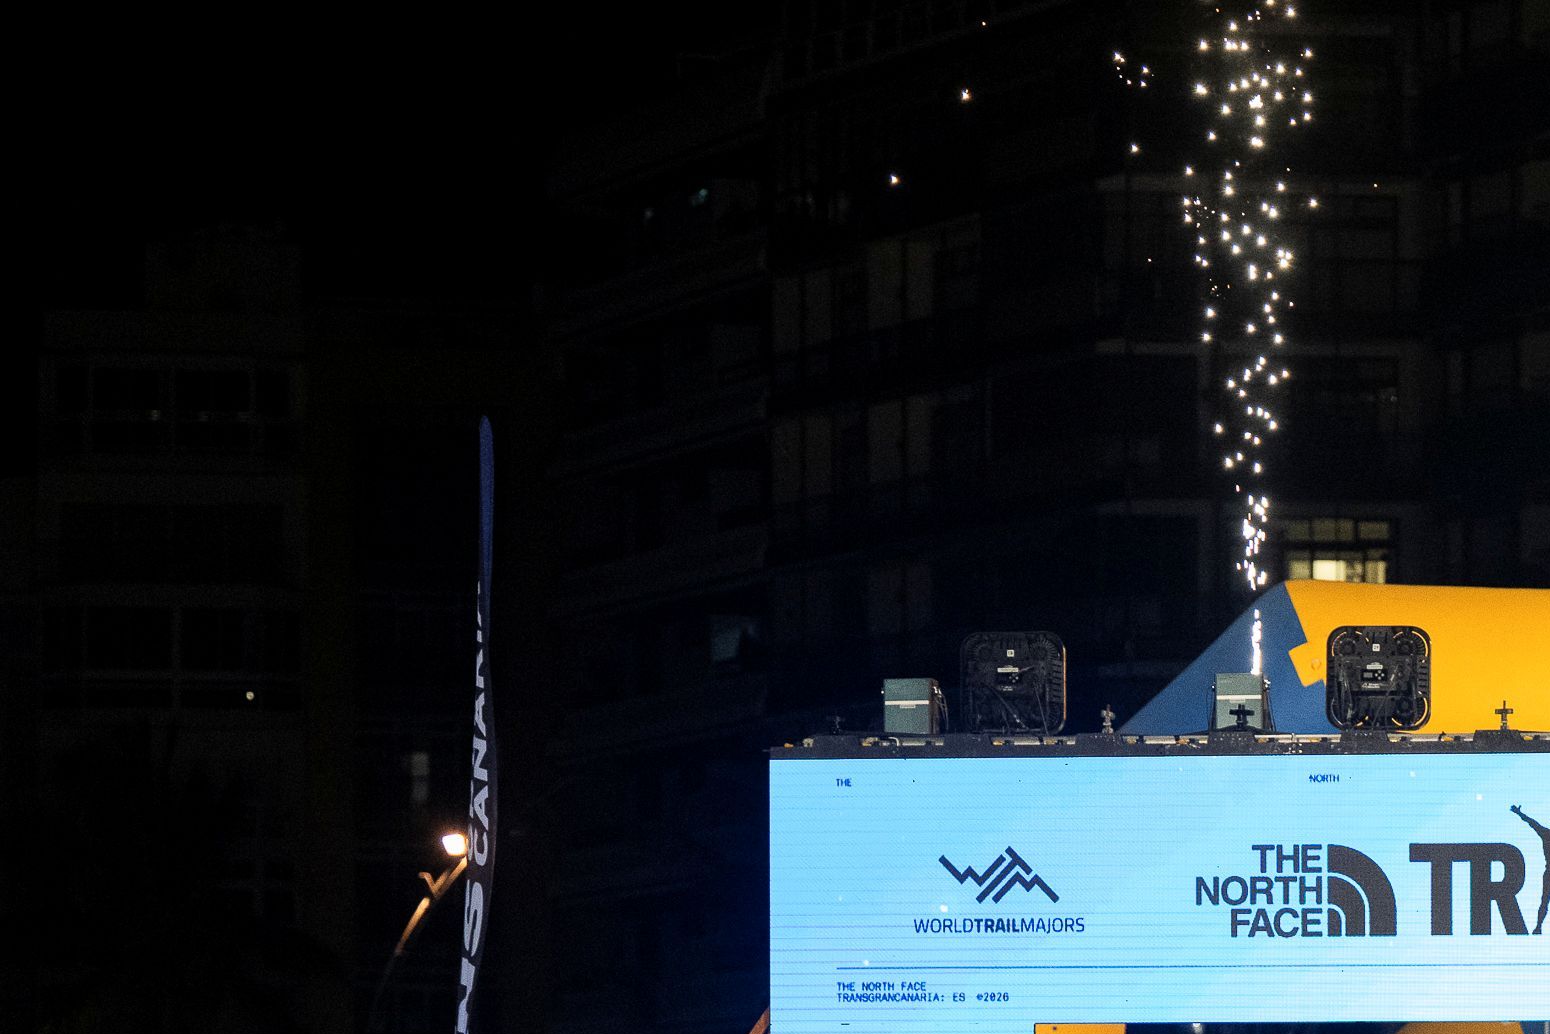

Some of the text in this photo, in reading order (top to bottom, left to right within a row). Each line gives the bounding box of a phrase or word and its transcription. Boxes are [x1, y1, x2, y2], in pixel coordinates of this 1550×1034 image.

[836, 778, 852, 787] THE
[1309, 774, 1340, 783] NORTH
[1251, 843, 1323, 874] THE
[1195, 875, 1323, 905] NORTH
[913, 917, 1085, 935] WORLDTRAILMAJORS
[1230, 907, 1323, 939] FACE
[837, 981, 927, 991] THE NORTH FACE
